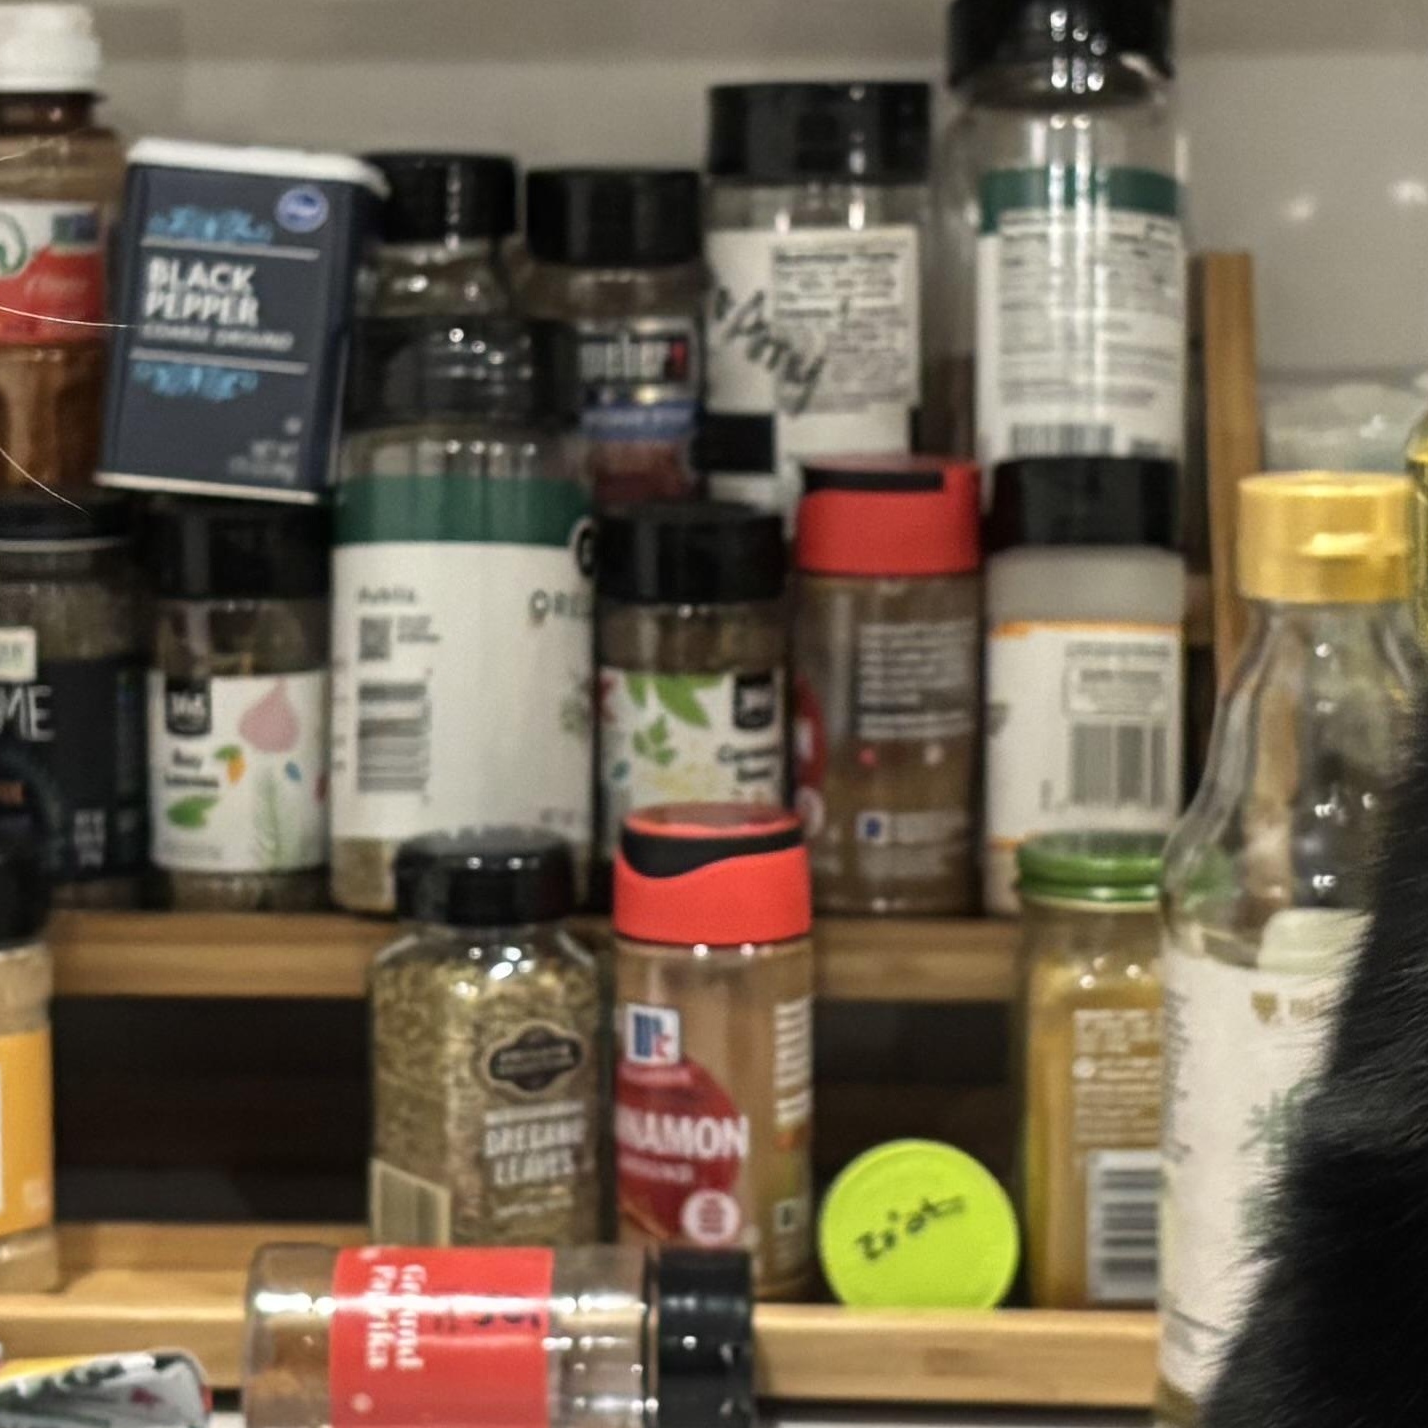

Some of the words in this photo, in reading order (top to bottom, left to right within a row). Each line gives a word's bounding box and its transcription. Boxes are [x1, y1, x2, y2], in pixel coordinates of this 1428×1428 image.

[148, 255, 257, 295] BLACK
[145, 290, 260, 328] PEPPER
[615, 1104, 750, 1160] NAMON
[365, 1263, 397, 1371] Parika
[396, 1263, 428, 1371] Grund
